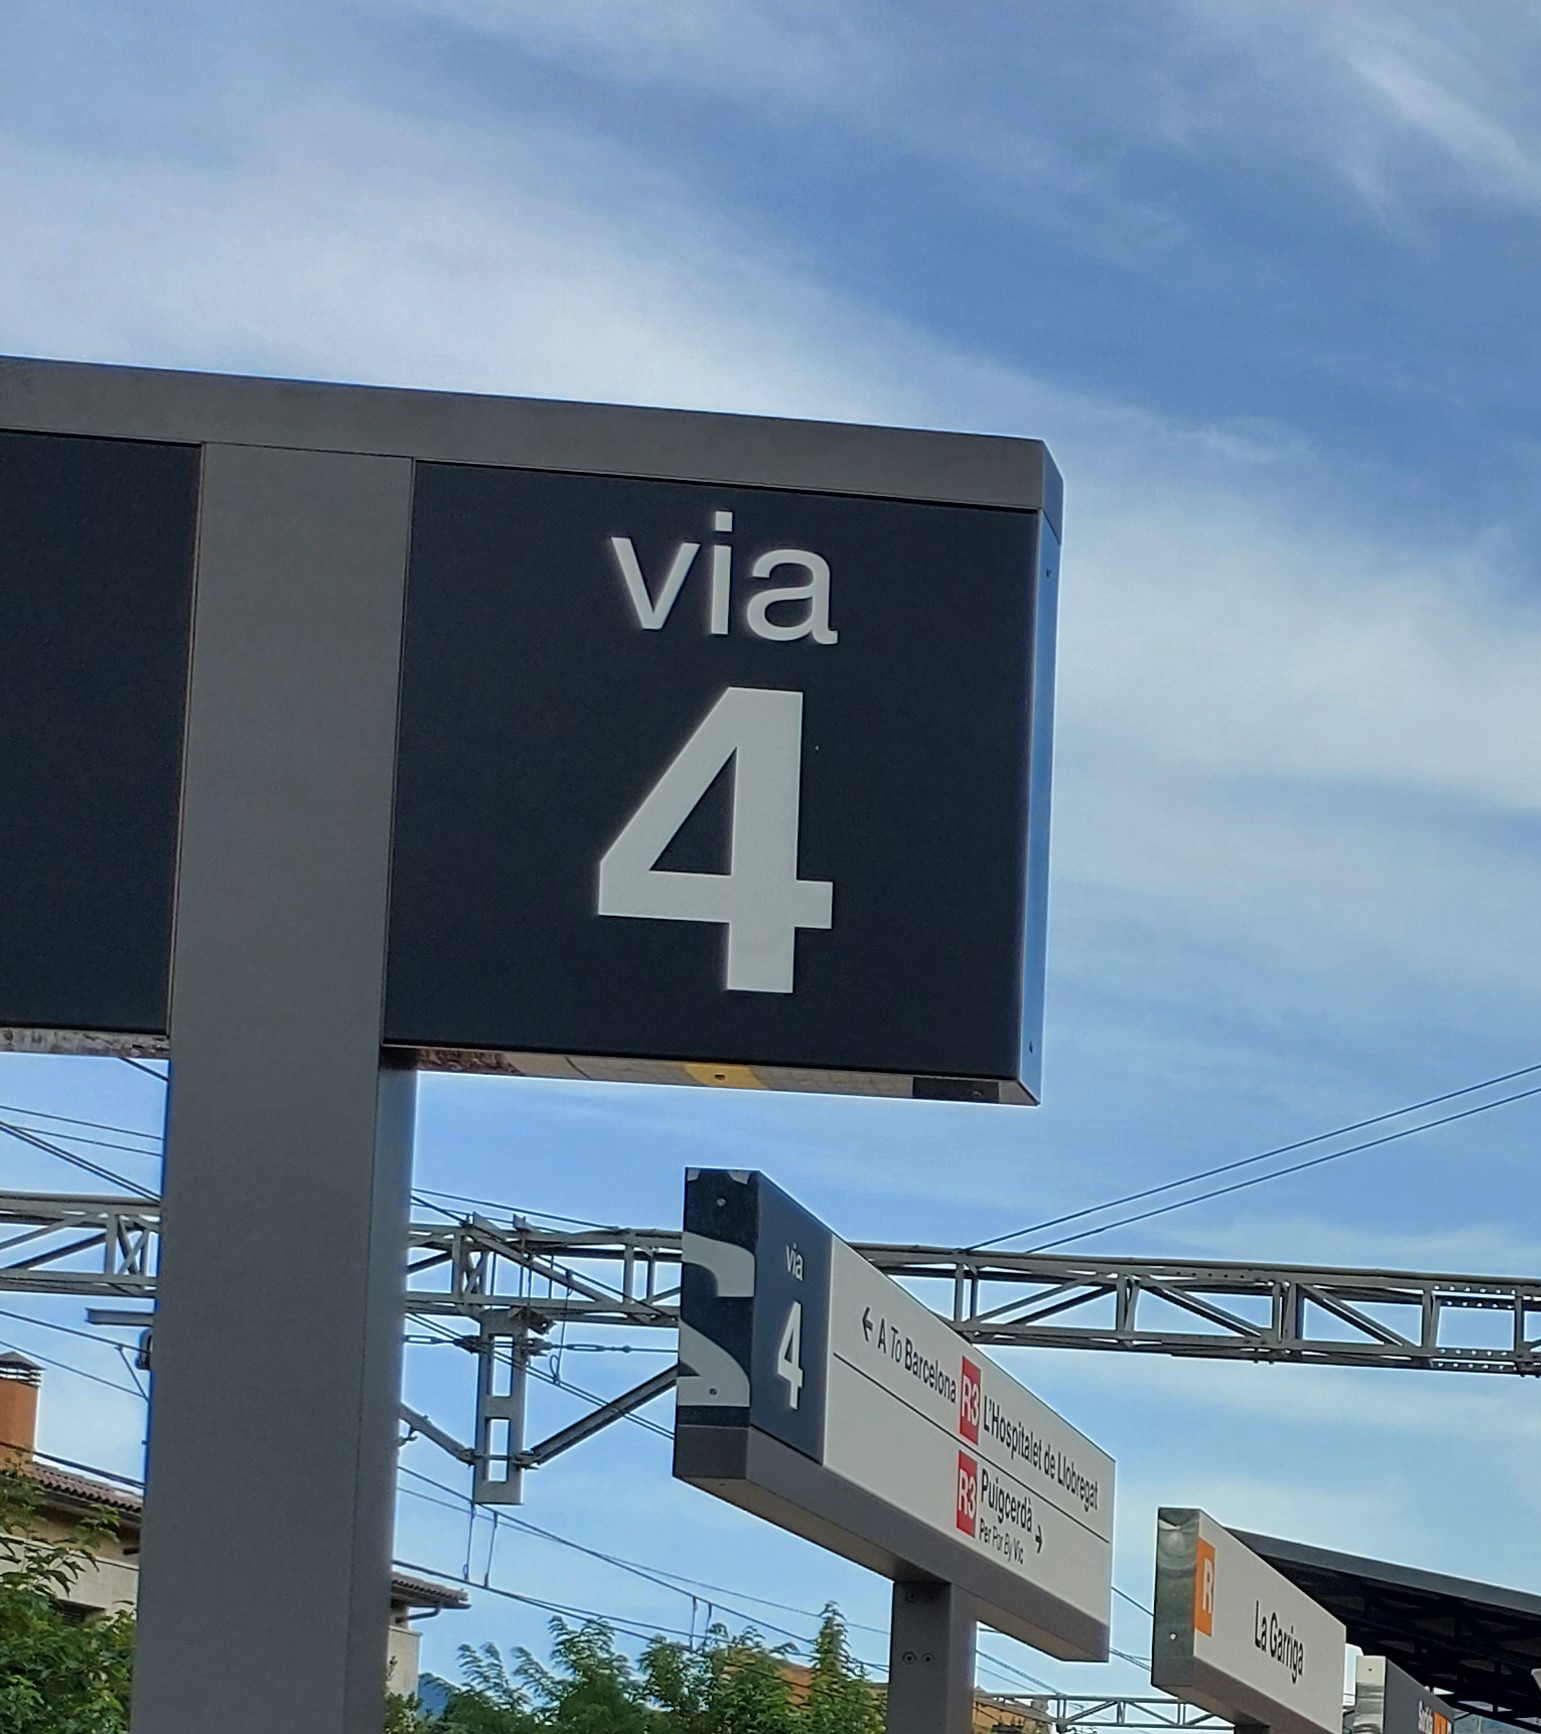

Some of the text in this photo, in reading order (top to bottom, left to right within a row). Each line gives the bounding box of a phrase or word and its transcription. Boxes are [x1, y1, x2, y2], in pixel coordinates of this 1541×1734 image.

[610, 510, 839, 646] via
[598, 686, 834, 994] 4
[785, 1242, 804, 1283] via
[777, 1300, 804, 1411] 4
[878, 1318, 957, 1404] A To Barcelona
[961, 1373, 1099, 1513] R3 L'Hospitalet de Llobregat
[959, 1467, 1033, 1533] R3 Puigcerdà
[979, 1517, 992, 1545] Per
[1202, 1557, 1214, 1614] R
[1254, 1599, 1304, 1685] La Garriga
